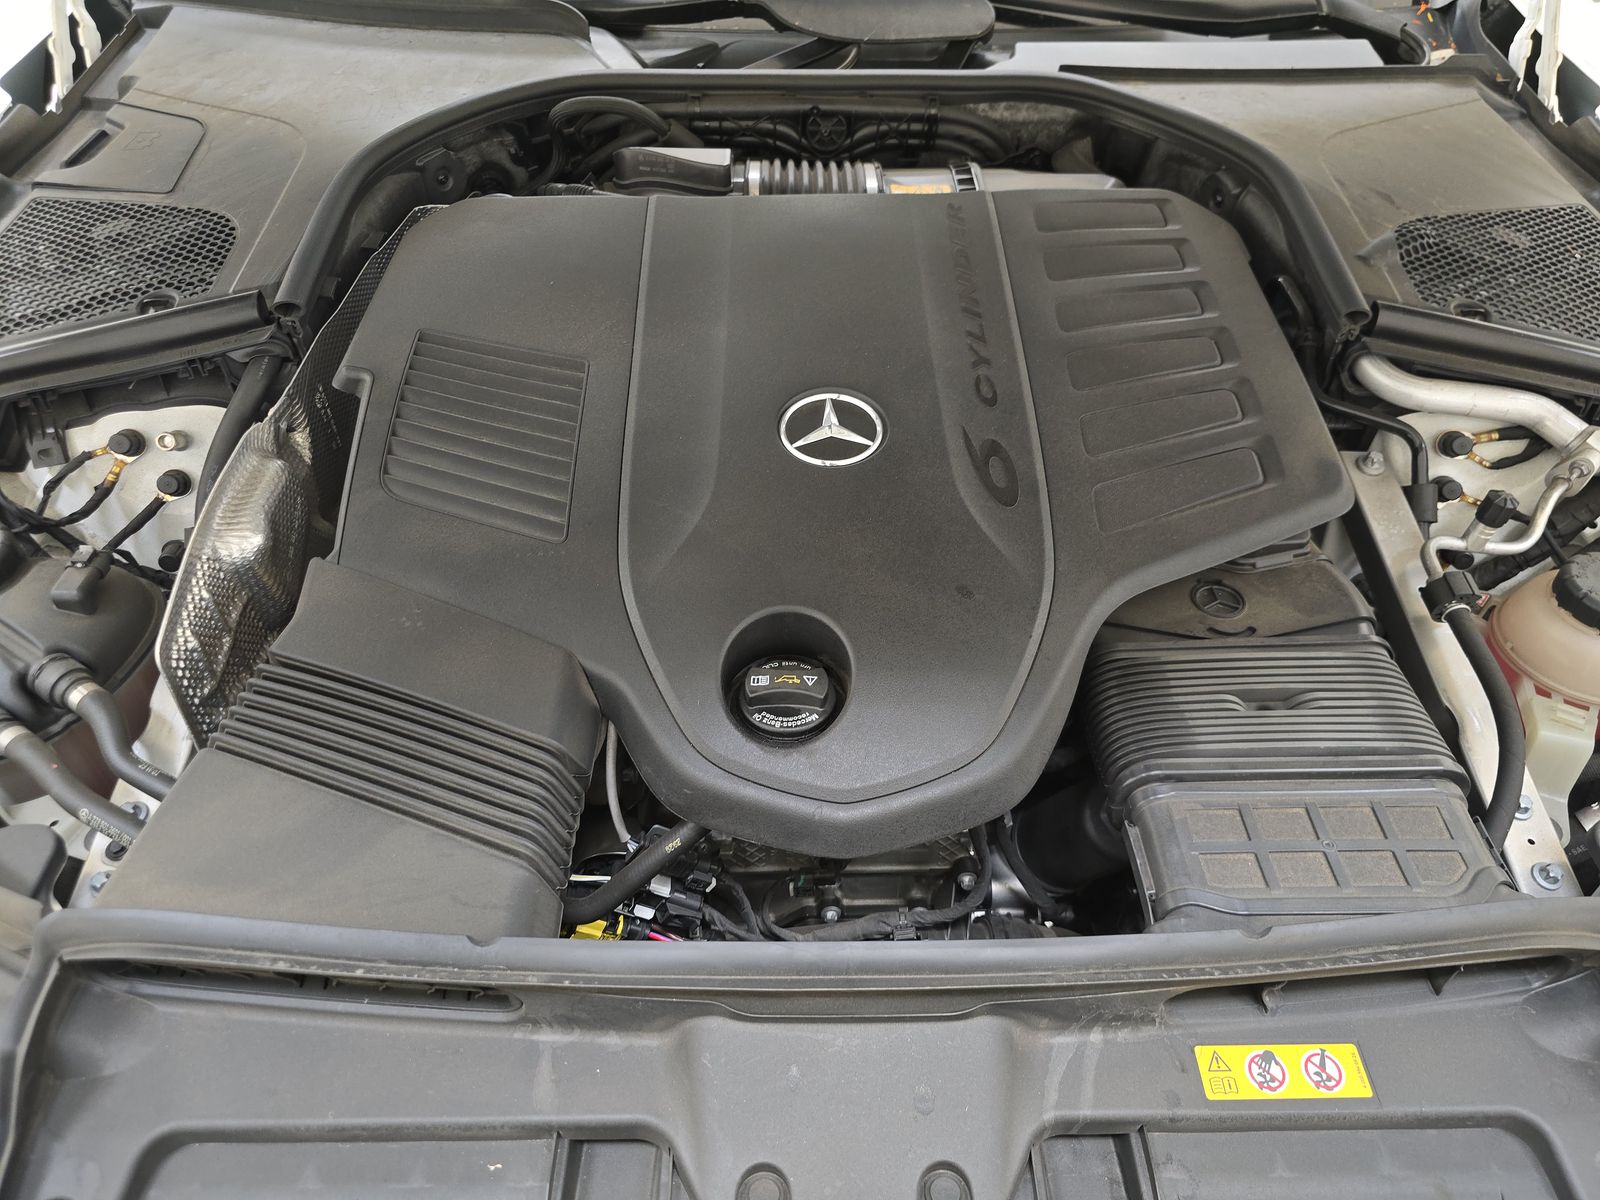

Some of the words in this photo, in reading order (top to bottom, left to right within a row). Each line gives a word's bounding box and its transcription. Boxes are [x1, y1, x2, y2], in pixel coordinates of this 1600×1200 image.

[947, 203, 998, 408] CYLINDER
[961, 425, 1020, 509] 6
[761, 711, 809, 721] recommended
[762, 713, 819, 727] Mercedes-Benz
